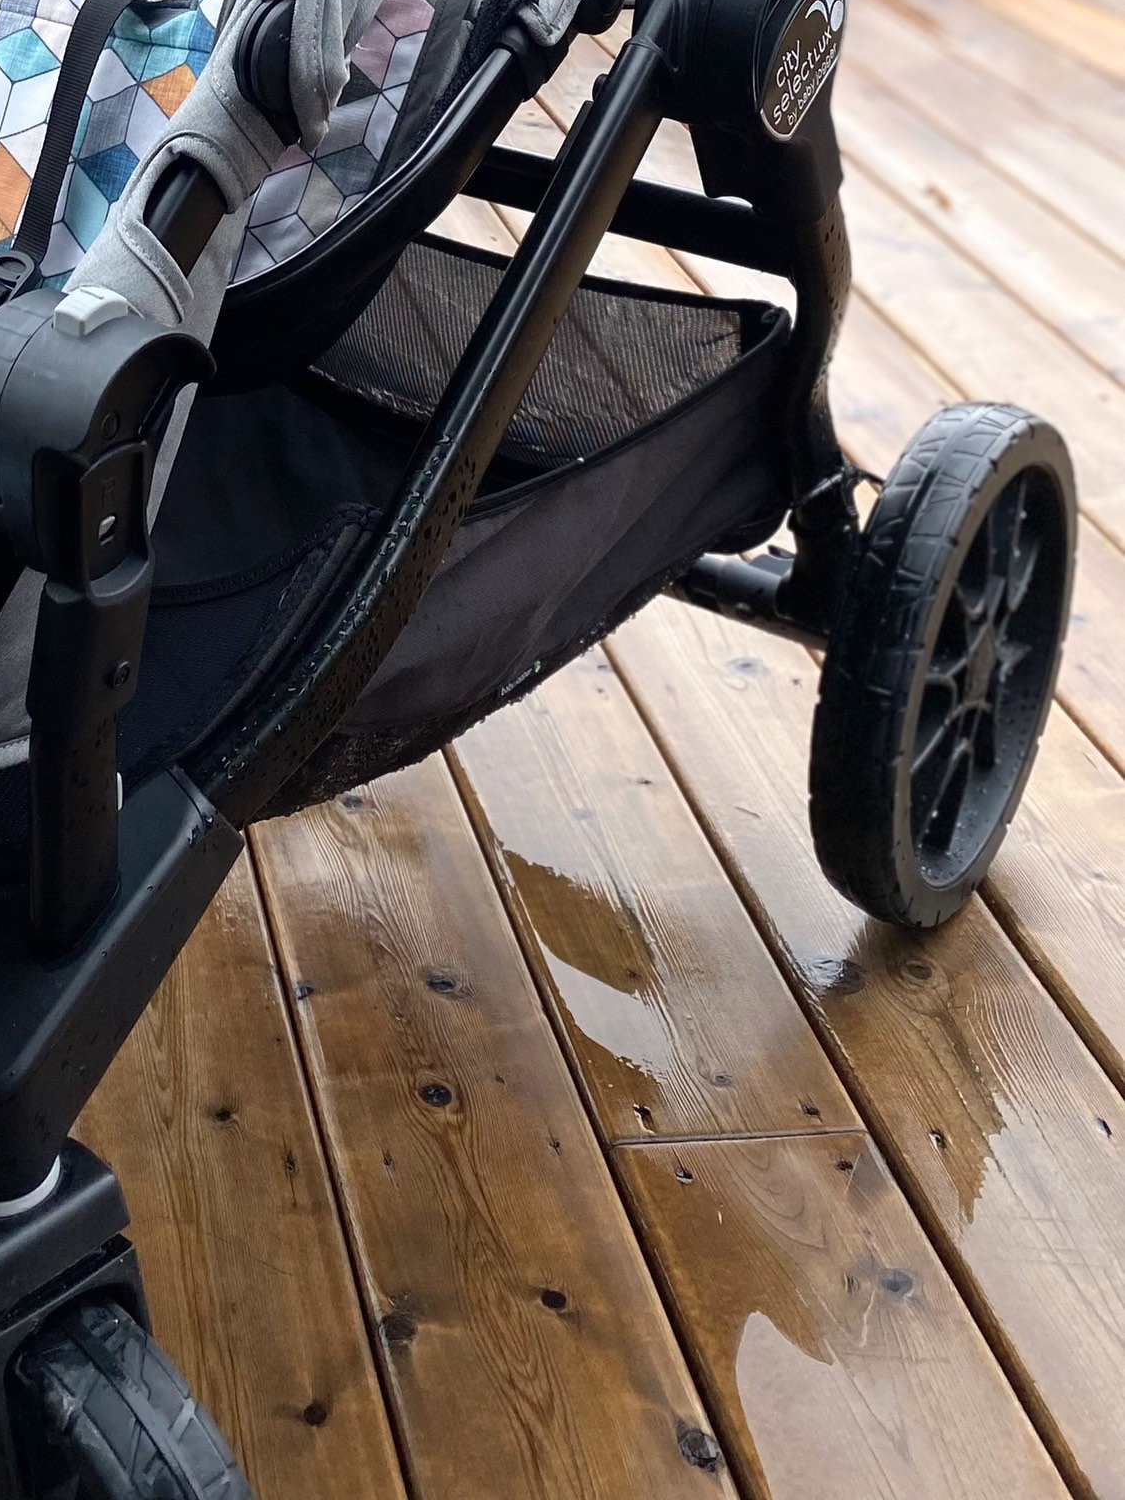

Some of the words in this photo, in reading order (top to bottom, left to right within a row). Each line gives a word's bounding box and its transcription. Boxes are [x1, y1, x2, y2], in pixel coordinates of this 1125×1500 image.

[776, 39, 801, 88] city
[787, 107, 799, 126] by
[798, 79, 816, 110] baby
[815, 43, 837, 85] jogger
